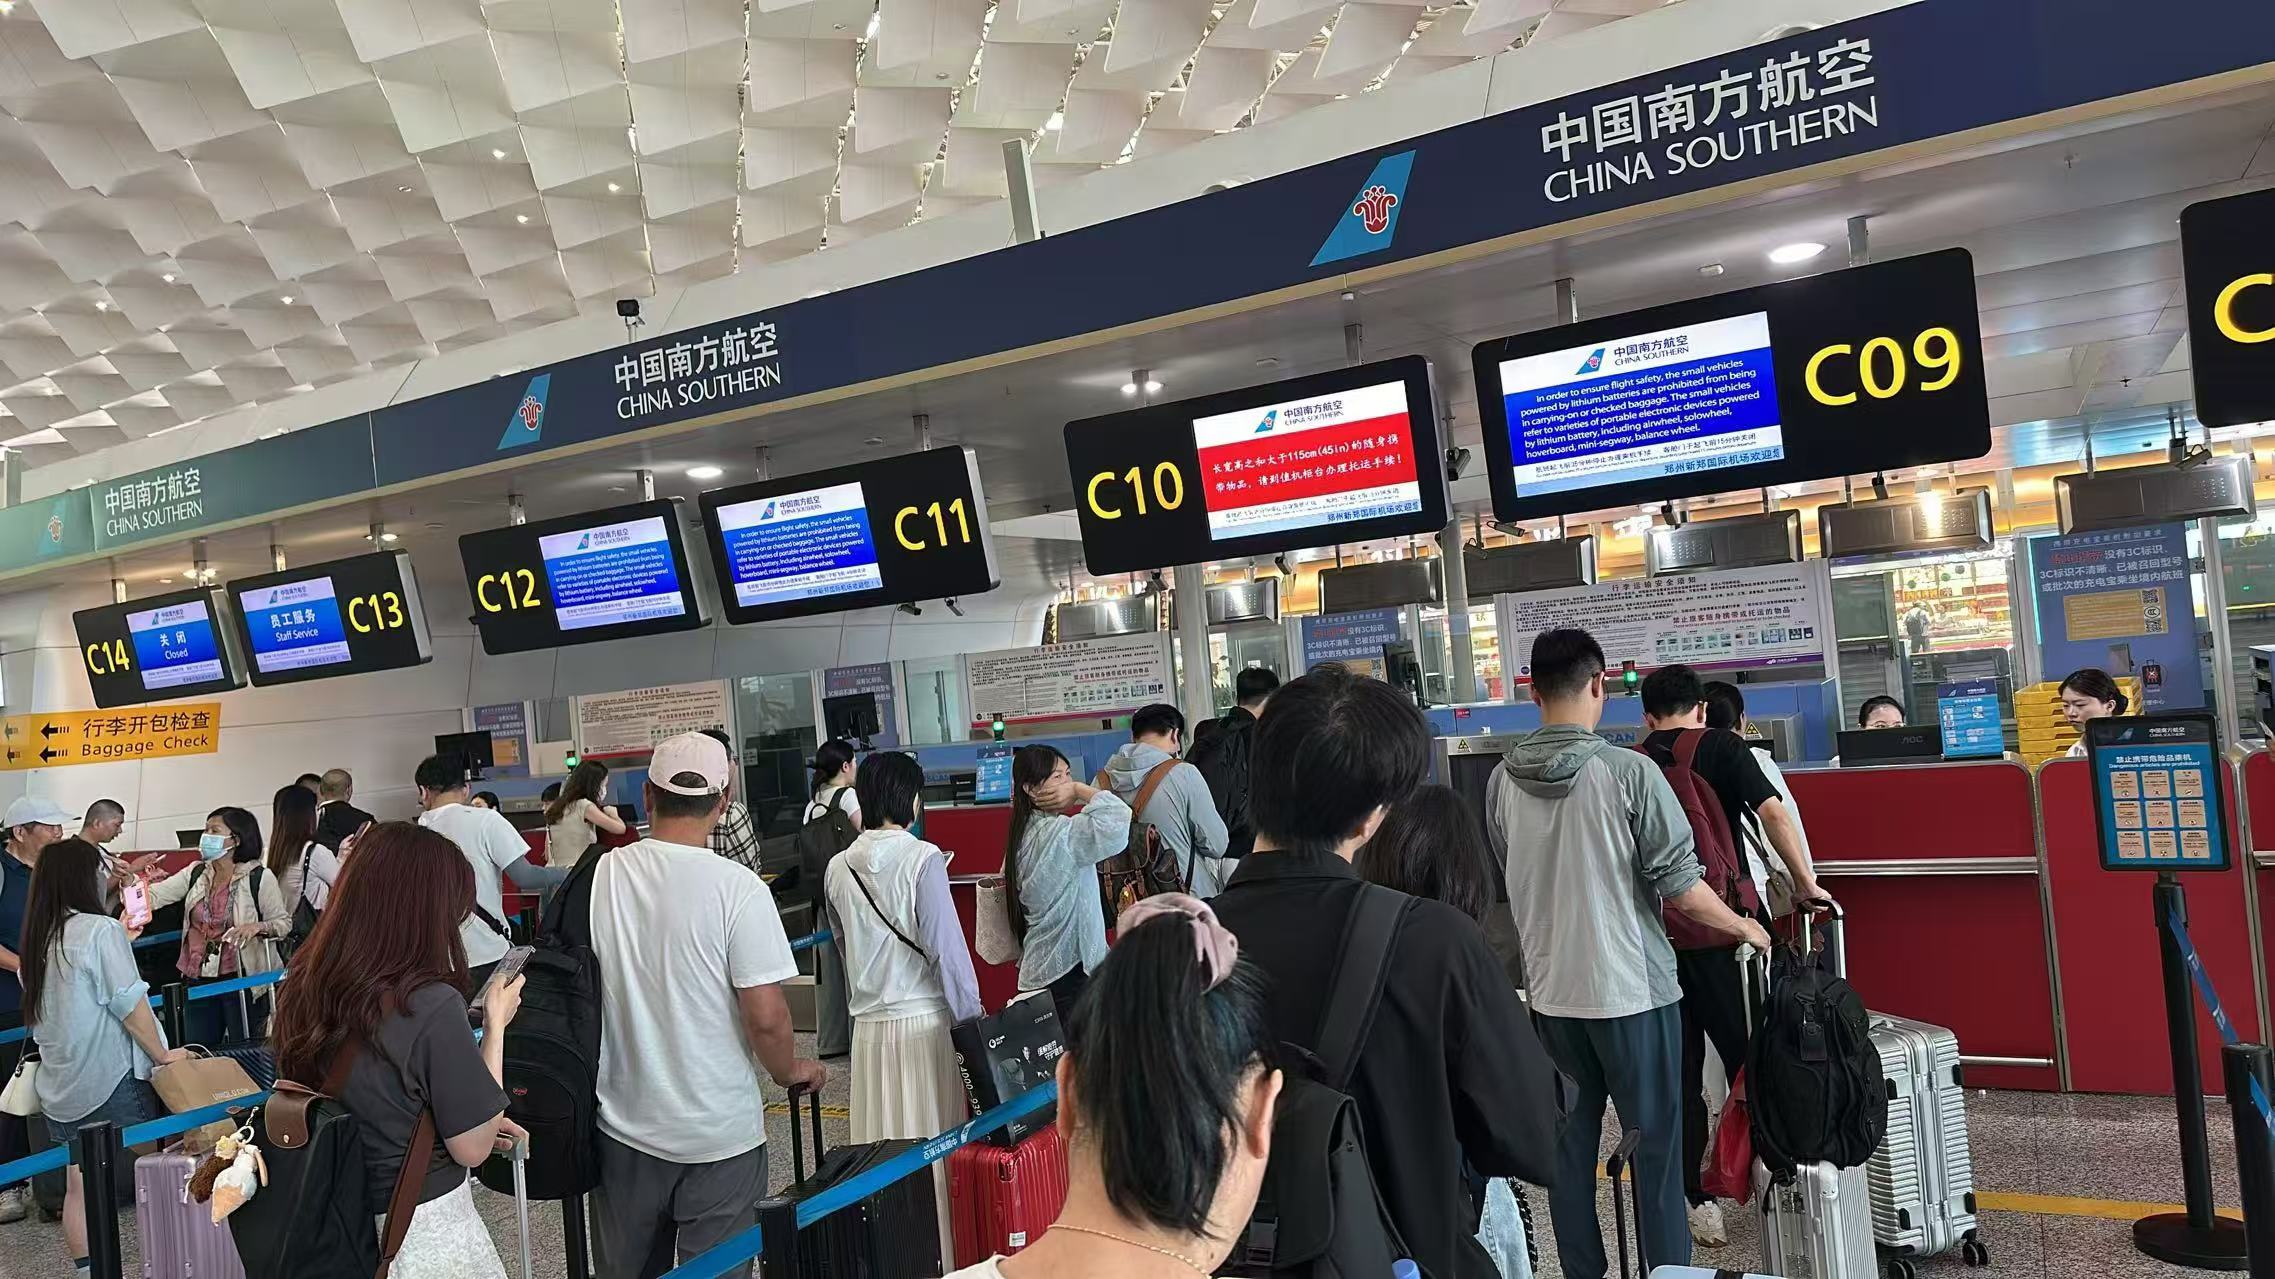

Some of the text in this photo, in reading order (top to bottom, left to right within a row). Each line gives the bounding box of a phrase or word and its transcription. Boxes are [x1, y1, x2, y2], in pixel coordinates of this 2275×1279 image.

[1541, 38, 1875, 163] 中国南方航空
[1544, 96, 1878, 202] CHINA SOUTHERN
[614, 321, 779, 392] 中国南方航空
[1613, 334, 1688, 358] 中国南方航空
[1614, 345, 1689, 366] CHINA SOUTHERN
[1805, 327, 1961, 406] C09
[617, 363, 781, 419] CHINA SOUTHERN
[1520, 402, 1557, 417] powered
[1558, 400, 1569, 410] by
[1570, 395, 1600, 407] lithium
[1602, 388, 1640, 401] batteries
[1656, 377, 1704, 393] prohibited
[1705, 373, 1727, 383] from
[1729, 368, 1756, 381] being
[1536, 358, 1743, 402] In order to ensure flight safety, the small vehicles
[1283, 399, 1342, 419] 中国南方航空
[1521, 418, 1529, 426] in
[1531, 410, 1578, 426] carrying-on
[1590, 402, 1626, 414] checked
[1628, 394, 1669, 409] baggage.
[1670, 391, 1687, 401] The
[1688, 387, 1712, 398] small
[1713, 380, 1750, 393] vehicles
[1523, 390, 1760, 436] refer to varieties of portable electronic devices powered
[1524, 406, 1732, 448] by lithium battery, including airwheel, solowheel,
[1526, 423, 1700, 458] hoverboard, mini-segway, balance wheel.
[105, 468, 201, 515] 中国南方航空
[1087, 461, 1184, 520] C10
[106, 499, 203, 536] CHINA SOUTHERN
[895, 498, 970, 551] C11
[476, 568, 541, 613] C12
[270, 608, 316, 628] 员工服务
[348, 591, 404, 633] C13
[86, 638, 130, 674] C14
[159, 630, 186, 648] 关闭
[164, 648, 188, 660] Closed
[276, 628, 318, 642] Staff Service
[83, 711, 210, 738] 行李开包检查
[1901, 736, 1924, 744] AOC
[82, 734, 208, 758] Baggage Check
